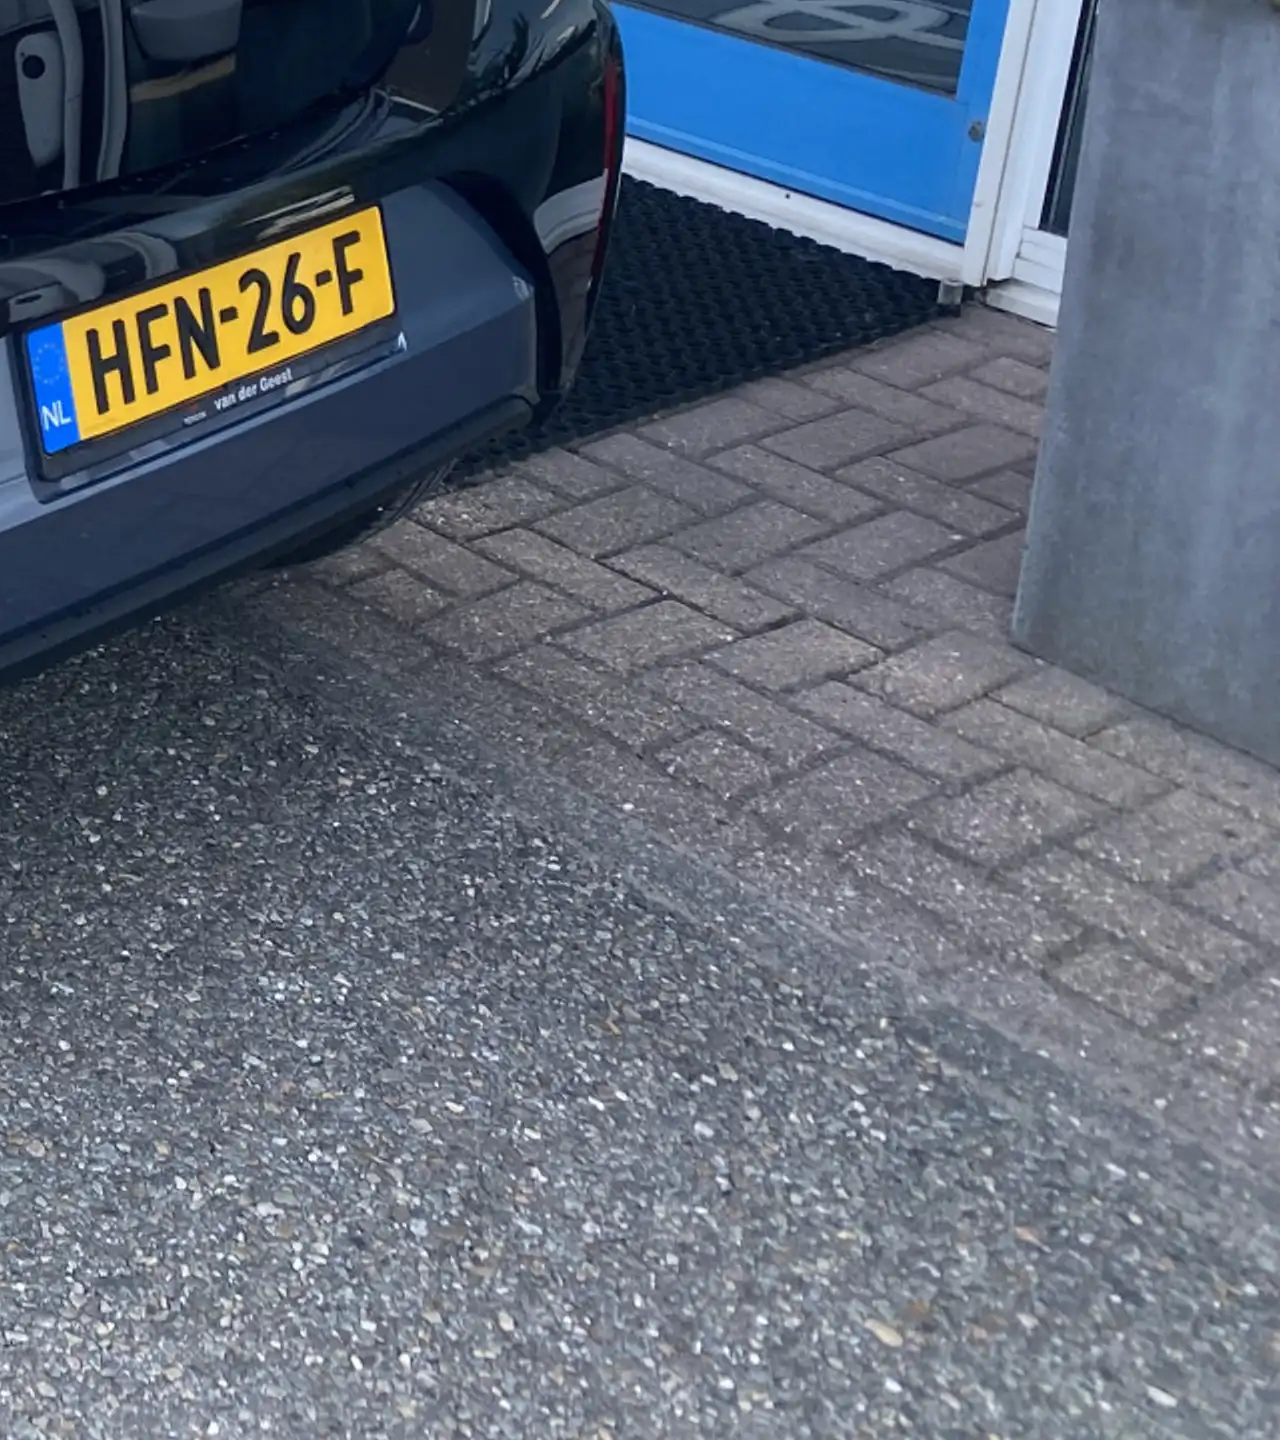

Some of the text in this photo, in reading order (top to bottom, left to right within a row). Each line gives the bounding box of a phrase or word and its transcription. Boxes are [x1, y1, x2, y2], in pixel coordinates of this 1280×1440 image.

[85, 229, 364, 416] HFN-26-F
[214, 368, 294, 411] van der Geest
[40, 398, 72, 432] NL
